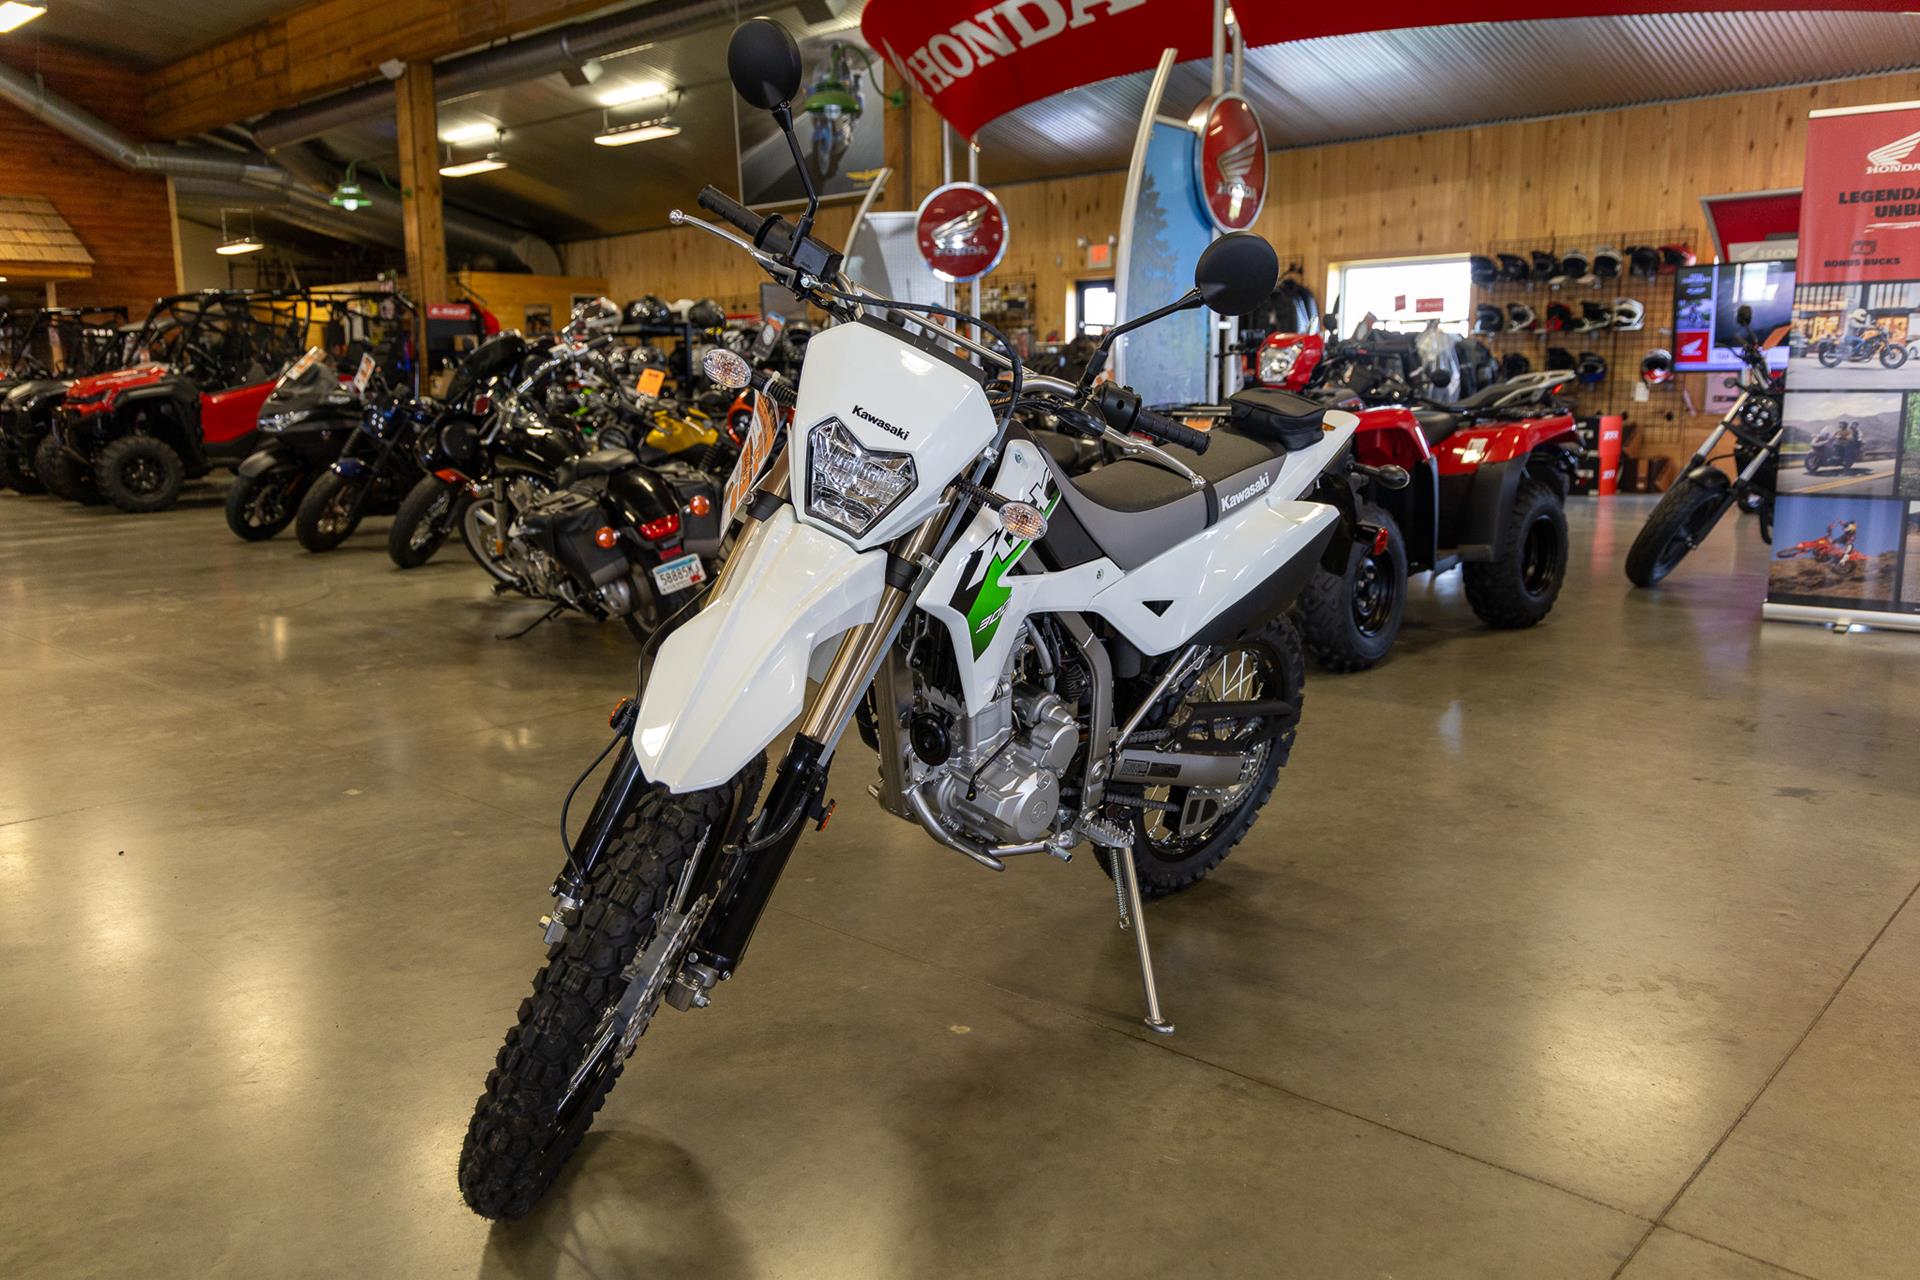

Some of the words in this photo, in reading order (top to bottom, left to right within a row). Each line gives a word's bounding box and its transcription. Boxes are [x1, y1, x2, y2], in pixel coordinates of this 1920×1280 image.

[1874, 203, 1920, 218] UNB
[1863, 256, 1902, 266] BUCKS
[852, 405, 910, 441] Kawasaki
[1221, 472, 1270, 513] Kawasaki
